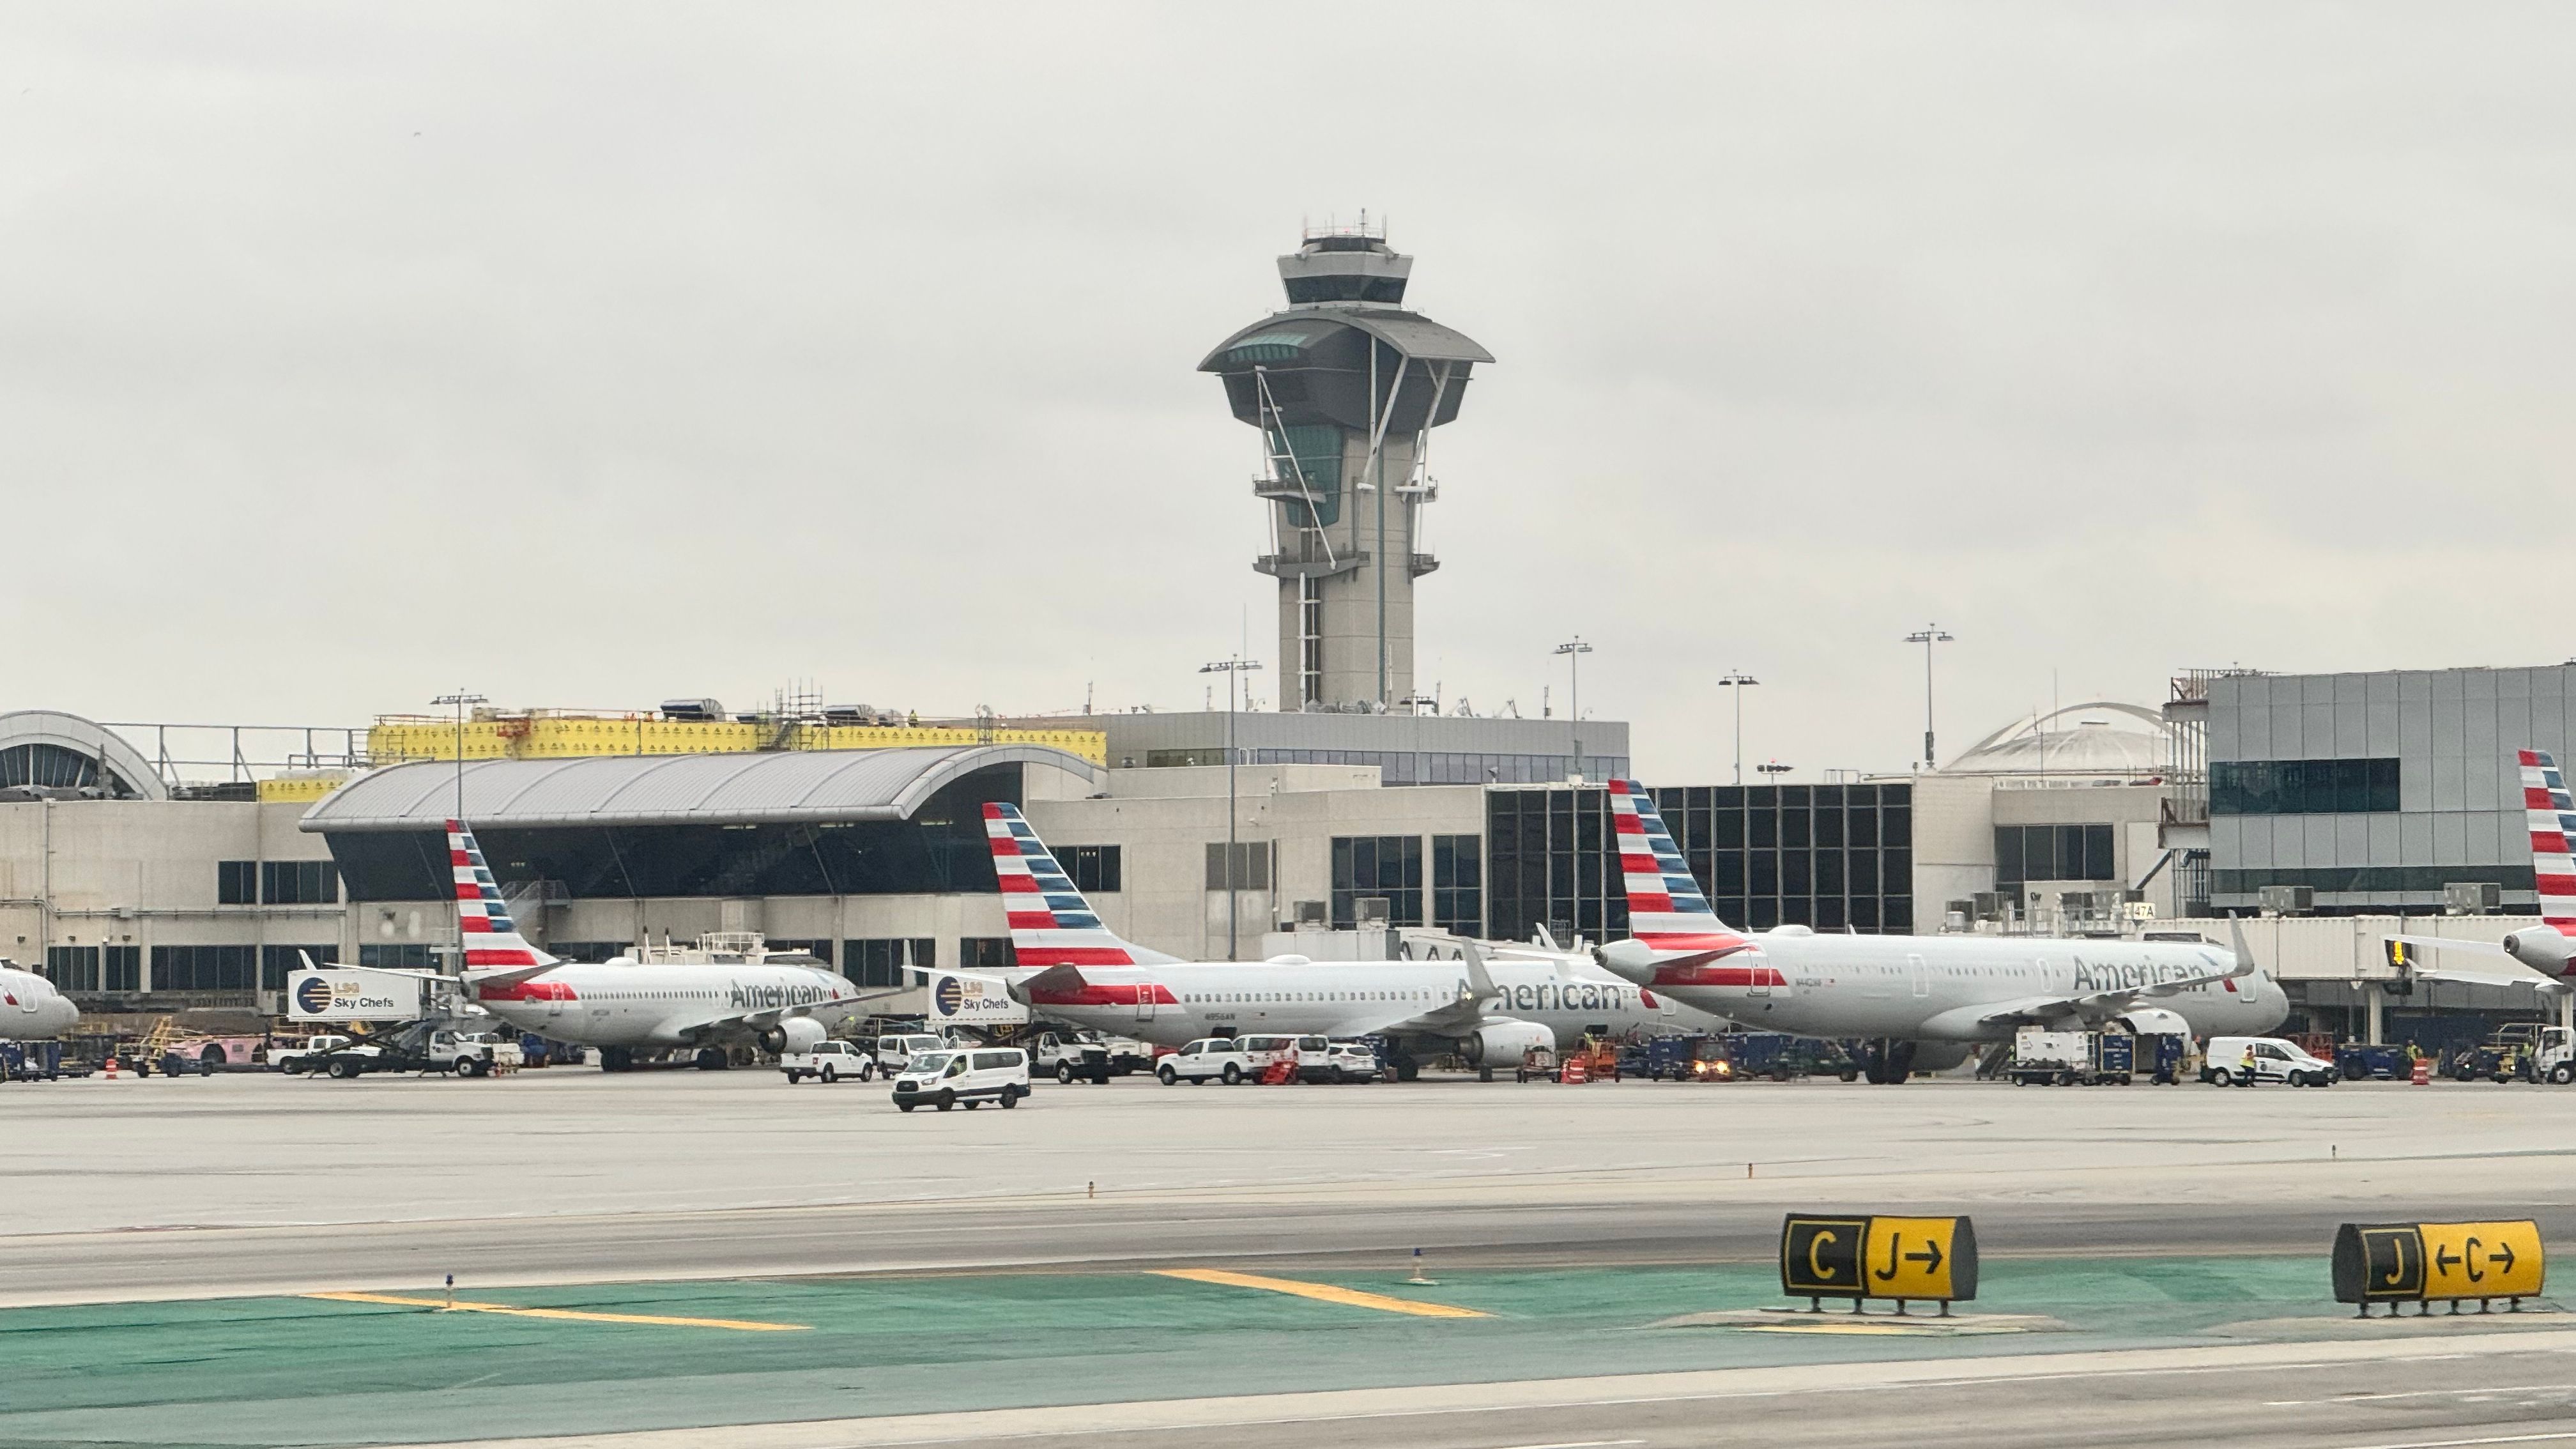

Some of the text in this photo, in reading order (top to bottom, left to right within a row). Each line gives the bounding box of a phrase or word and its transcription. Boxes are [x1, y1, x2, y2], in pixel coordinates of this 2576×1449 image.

[2135, 905, 2154, 916] 47A
[2073, 954, 2207, 992] American
[334, 997, 394, 1009] Sky Chefs
[730, 976, 824, 1008] American
[963, 998, 1009, 1011] Sky Chefs
[1809, 1230, 1901, 1280] C J
[2385, 1237, 2484, 1285] J C
